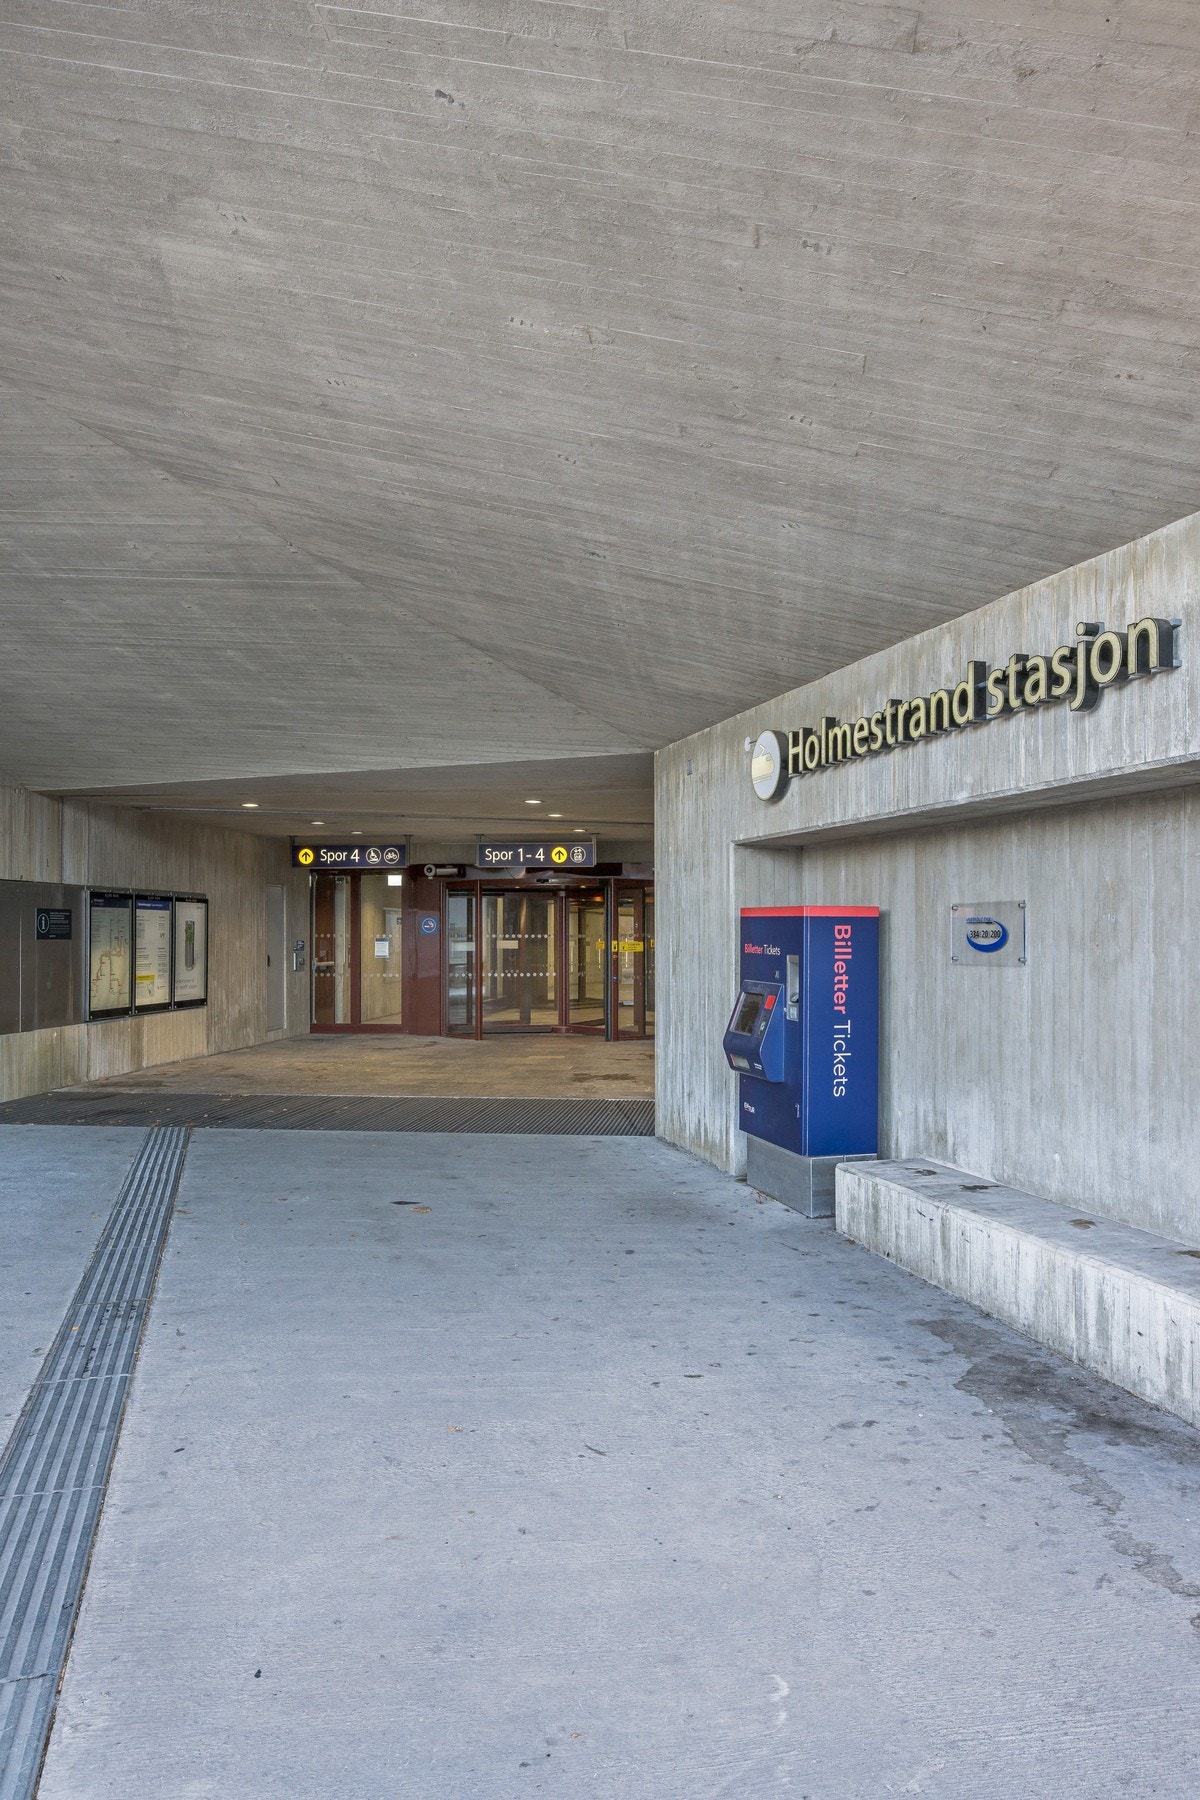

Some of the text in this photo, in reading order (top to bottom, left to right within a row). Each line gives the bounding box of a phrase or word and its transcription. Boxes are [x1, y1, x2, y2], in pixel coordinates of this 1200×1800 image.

[788, 616, 1166, 777] Holmestrand stasjon
[319, 848, 360, 864] Spor 4
[484, 847, 514, 863] Spor
[744, 943, 781, 956] Billetter Tickets
[833, 924, 852, 1097] Billetter Tickets
